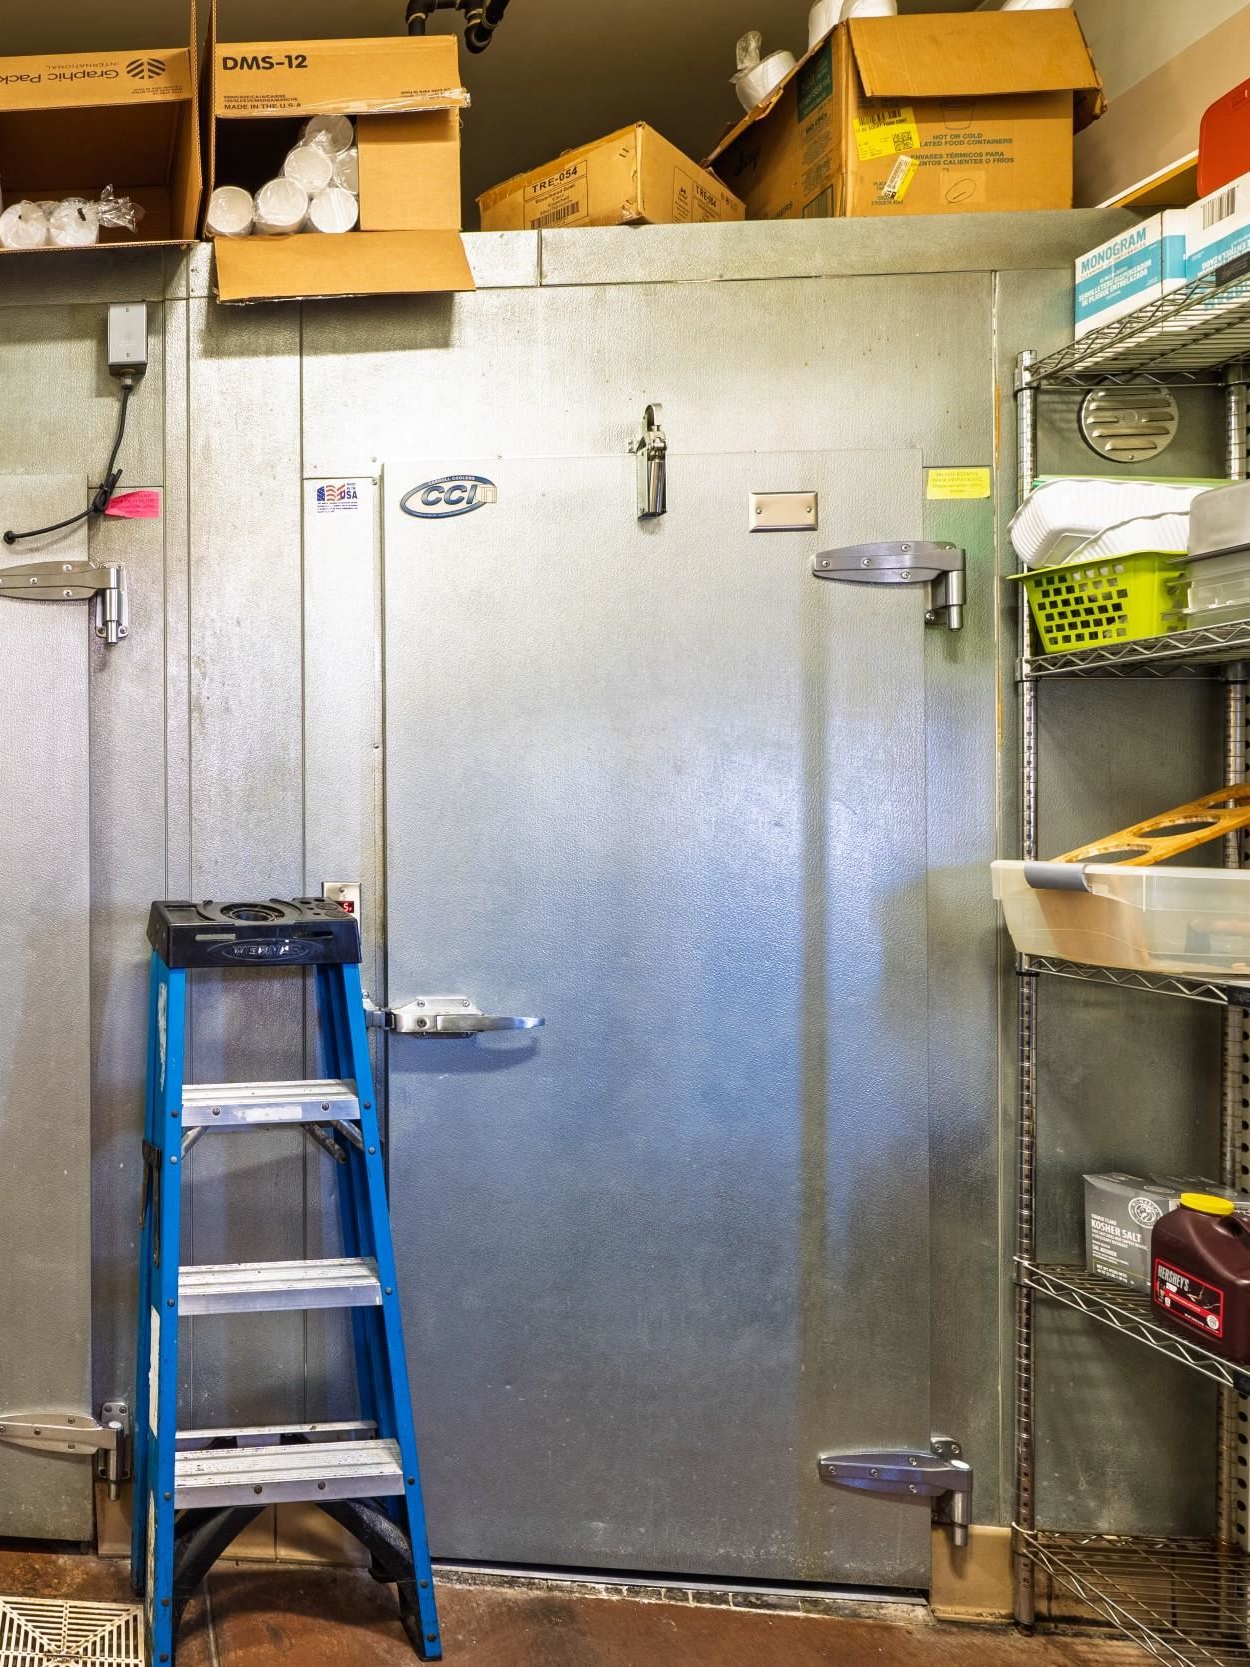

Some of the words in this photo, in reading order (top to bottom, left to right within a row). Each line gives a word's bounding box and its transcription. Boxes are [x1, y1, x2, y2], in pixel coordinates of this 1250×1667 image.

[222, 54, 309, 71] DMS-12
[47, 69, 119, 82] Graphic
[967, 138, 1013, 146] CONTAINERS
[943, 158, 984, 166] CALIENTES
[531, 165, 578, 194] TRE-054
[1081, 227, 1147, 275] MONOGRAM
[420, 484, 479, 506] CCI
[1091, 1218, 1121, 1237] KOSHER
[1122, 1229, 1142, 1242] SALT
[1157, 1264, 1190, 1292] HERSHEY'S
